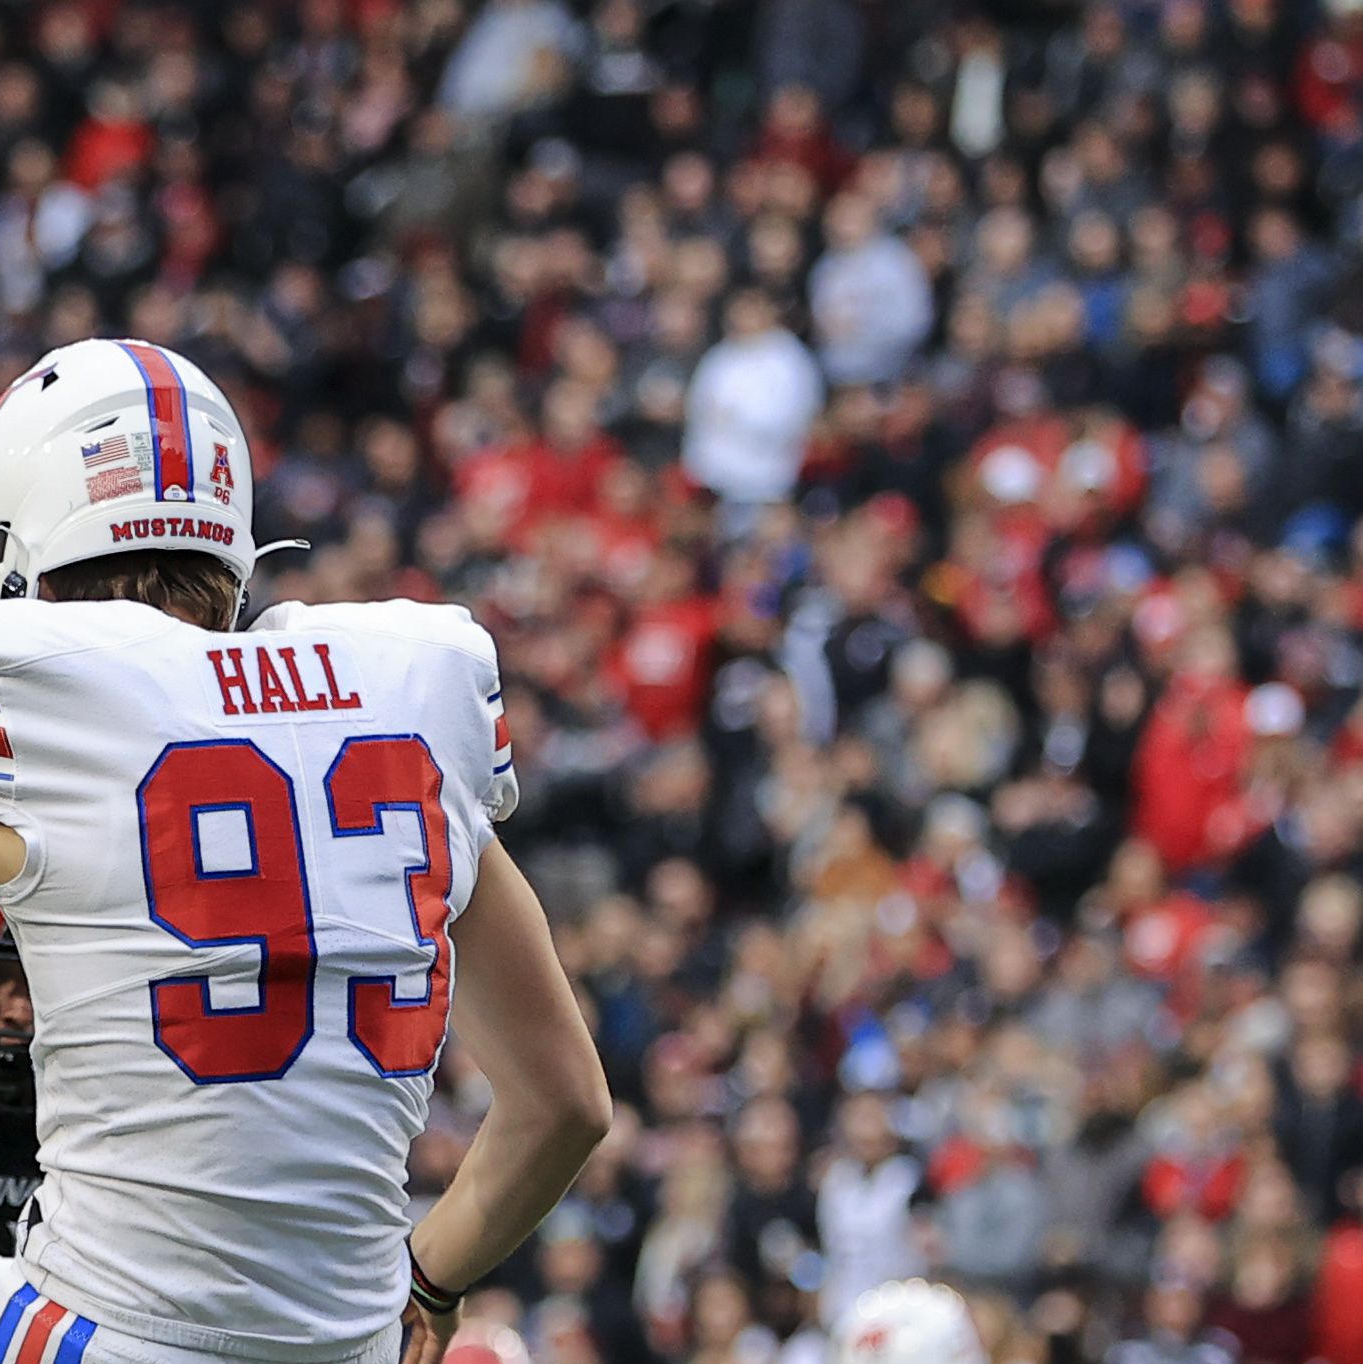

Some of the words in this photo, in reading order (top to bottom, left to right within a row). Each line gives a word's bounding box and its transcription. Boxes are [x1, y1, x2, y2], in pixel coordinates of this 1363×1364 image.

[110, 517, 236, 546] MUSTANGS
[206, 644, 363, 716] HALL
[136, 733, 454, 1085] 93
